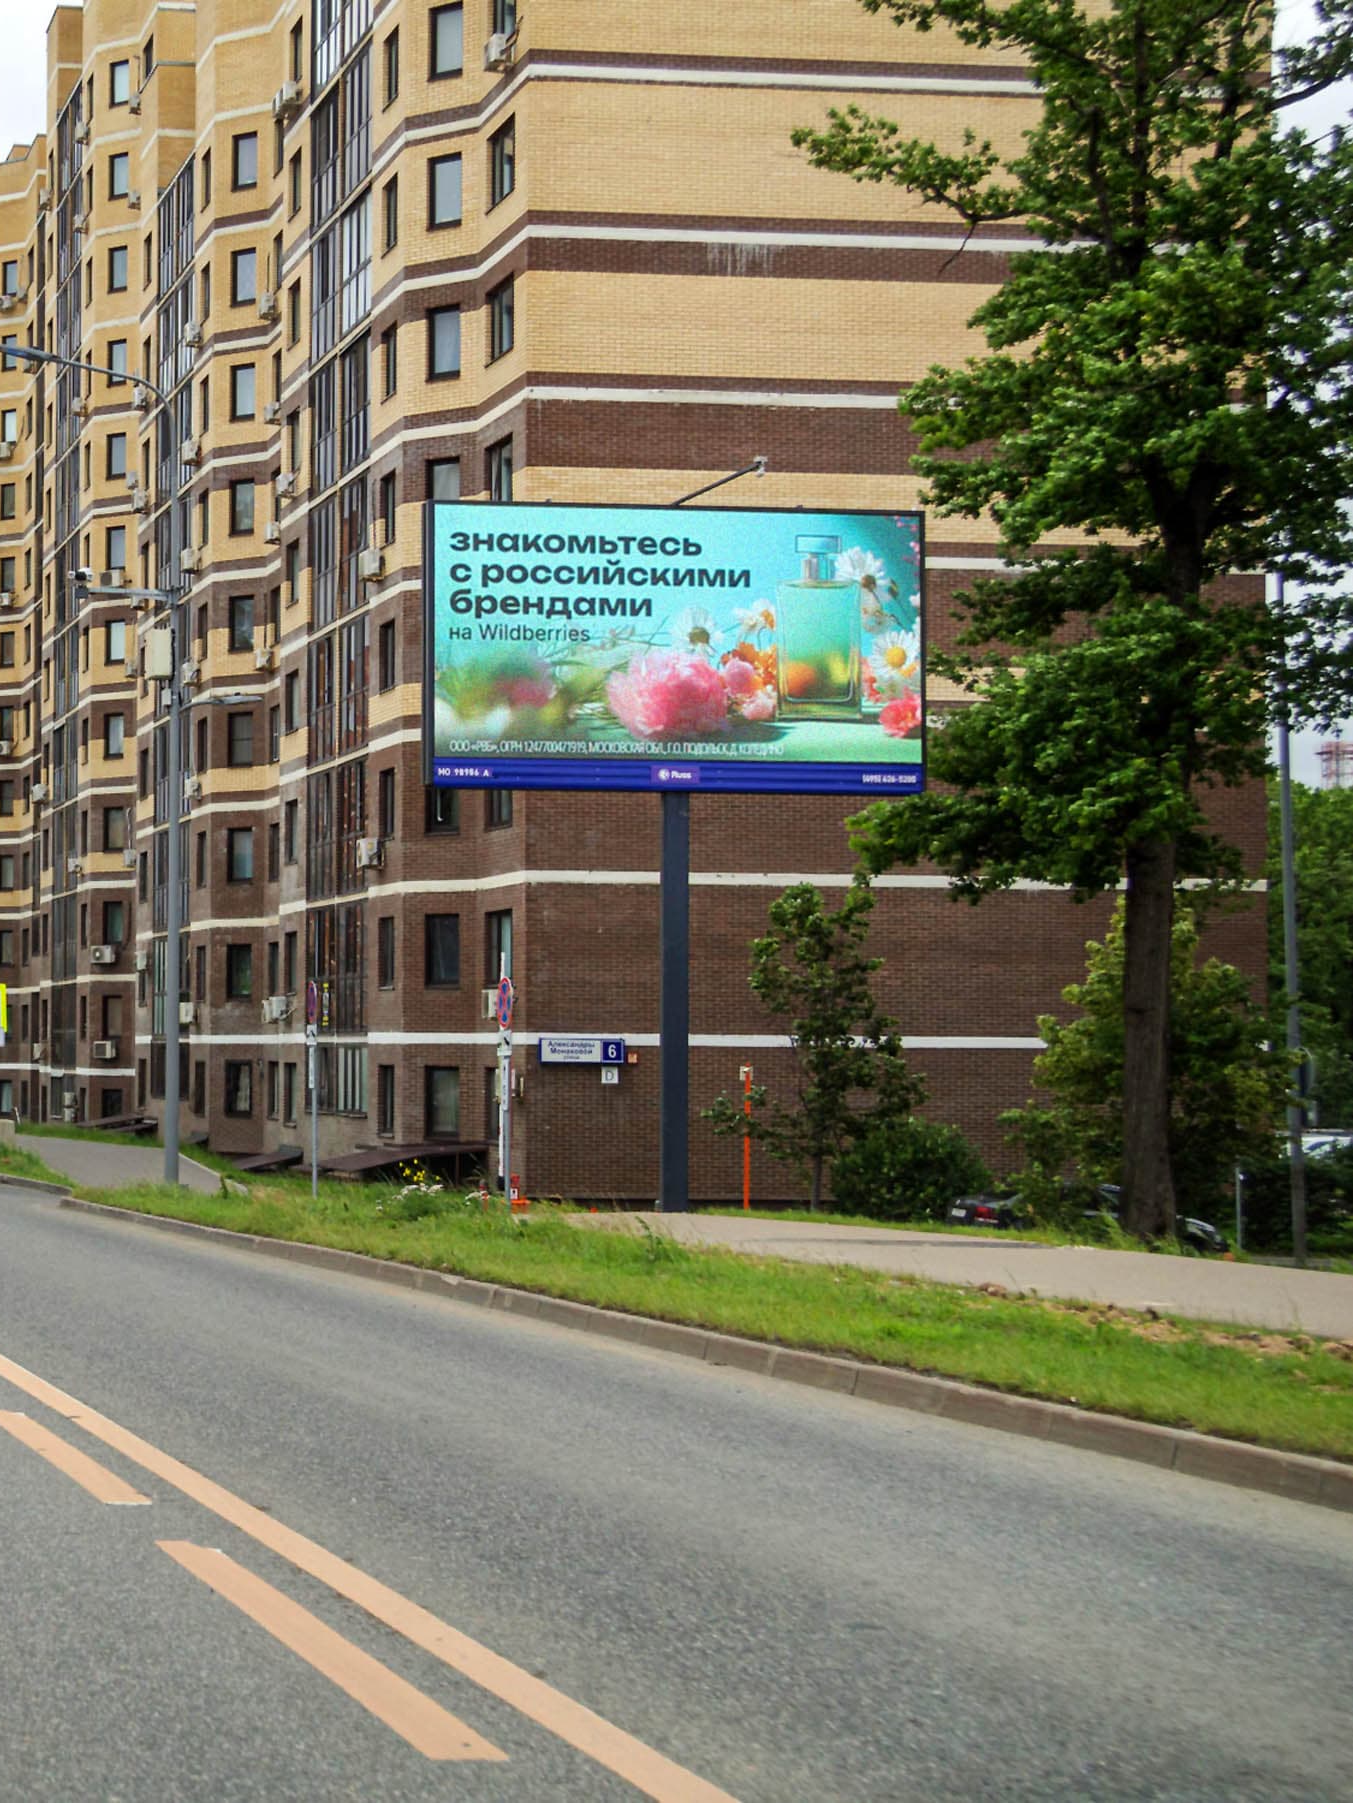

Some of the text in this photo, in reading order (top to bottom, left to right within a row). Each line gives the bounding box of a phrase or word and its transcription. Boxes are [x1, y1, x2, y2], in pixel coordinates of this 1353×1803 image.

[449, 531, 703, 556] знакомьтесь
[449, 559, 751, 588] с российскими
[449, 588, 653, 619] брендами
[448, 623, 591, 642] на Wildberries
[449, 739, 470, 752] ООО
[608, 1044, 617, 1059] 6
